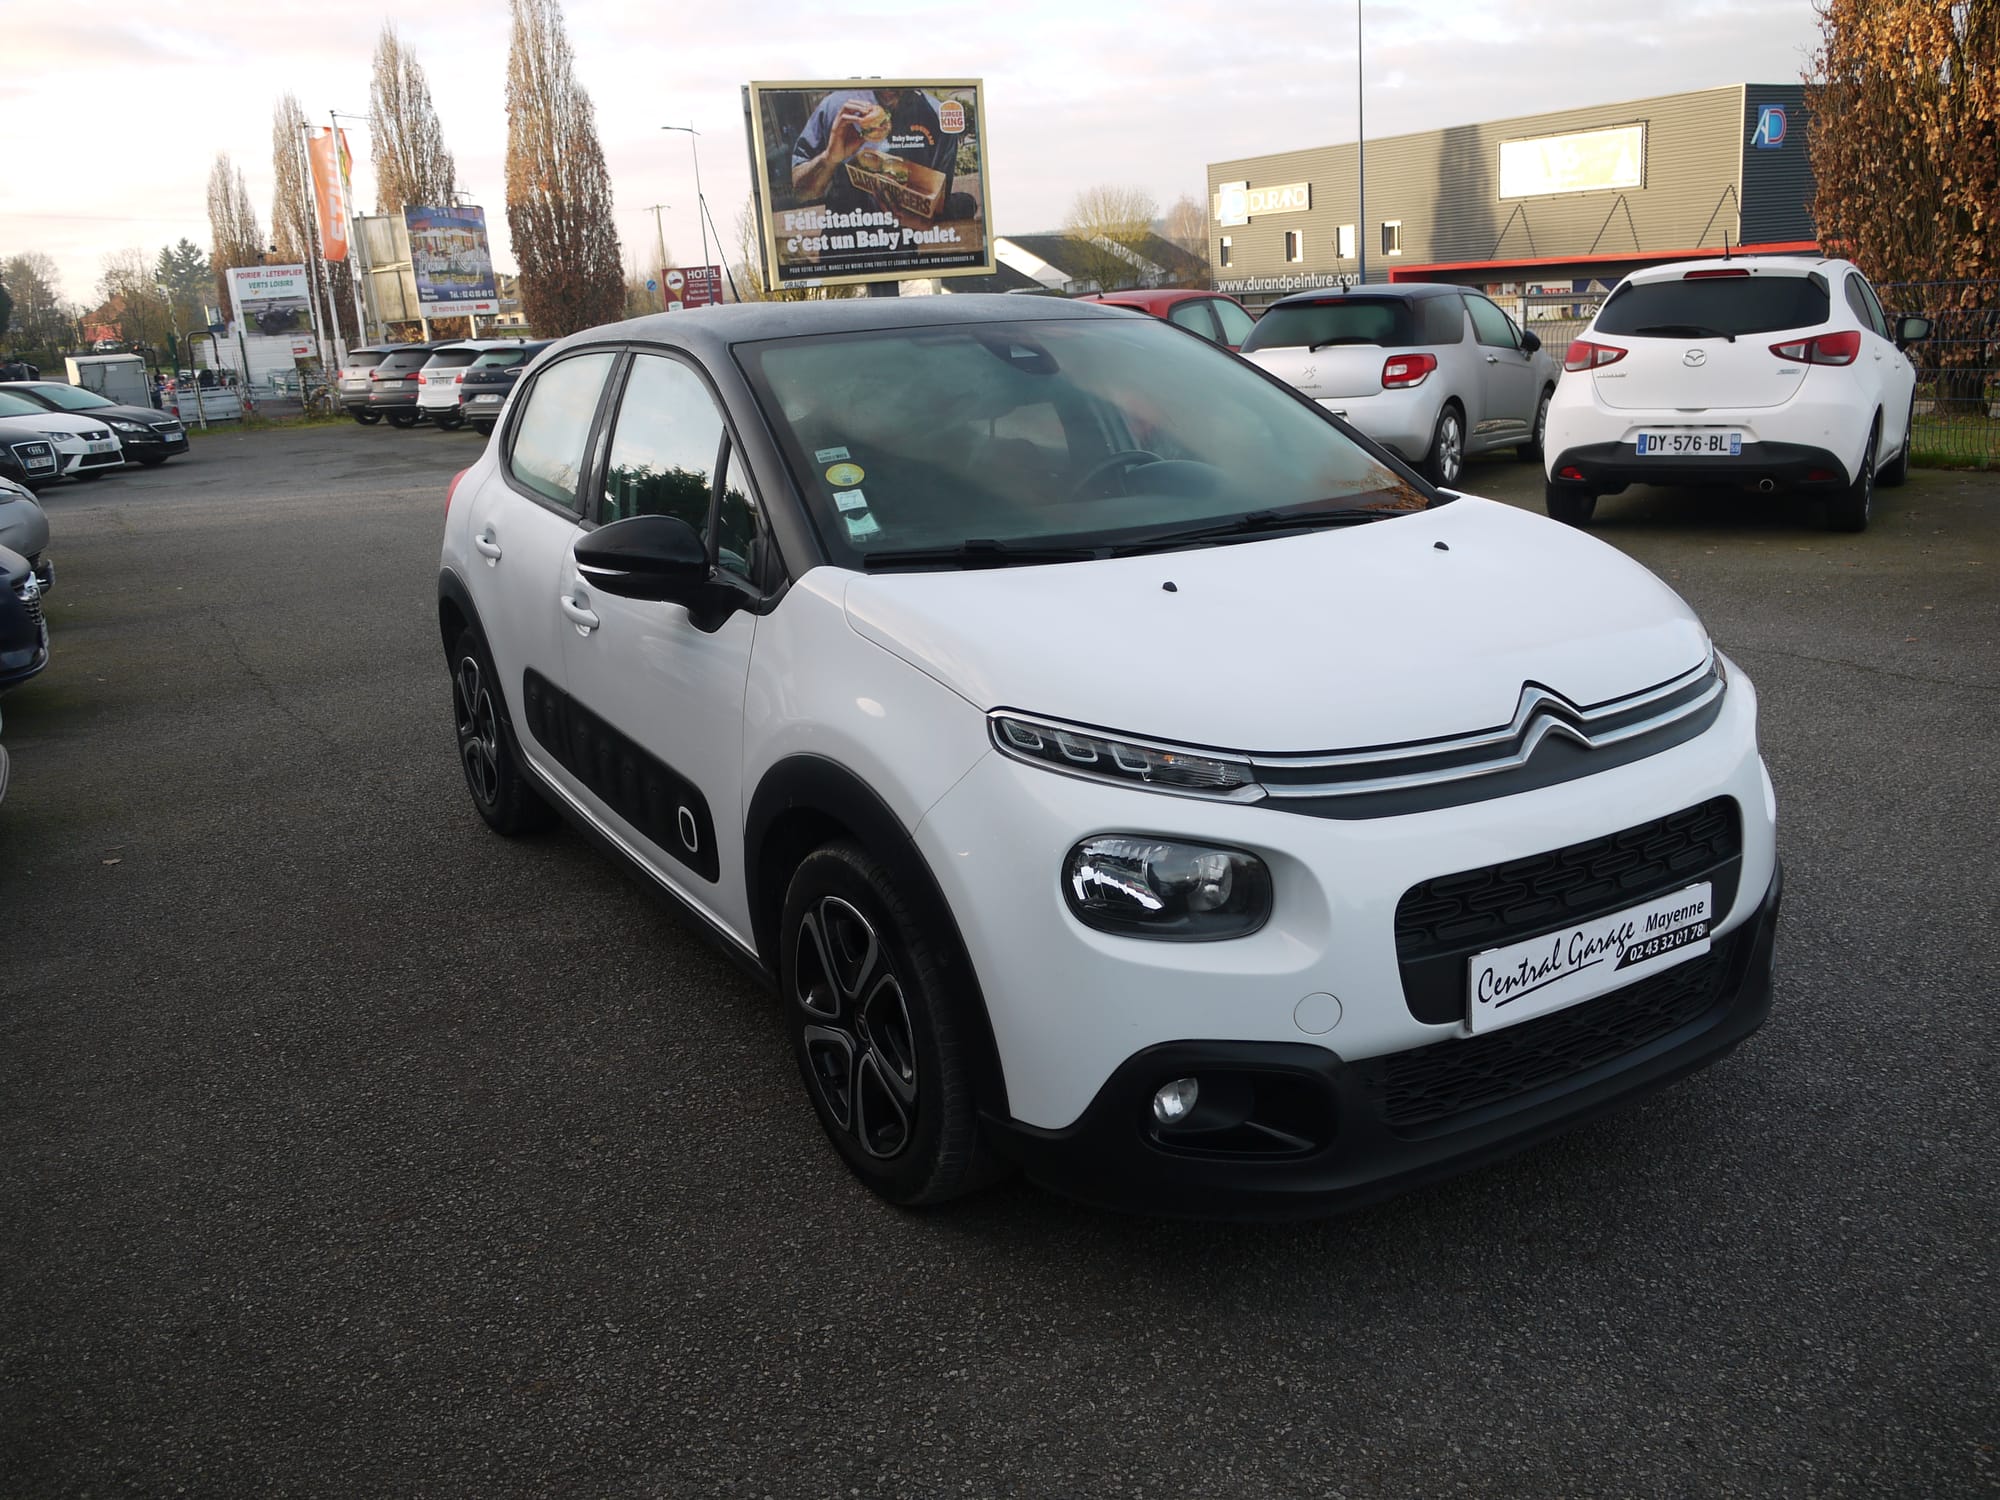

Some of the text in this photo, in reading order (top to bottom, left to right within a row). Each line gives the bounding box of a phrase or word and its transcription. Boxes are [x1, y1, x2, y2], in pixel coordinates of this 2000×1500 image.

[942, 117, 963, 127] KING
[1751, 108, 1787, 144] AD
[1250, 187, 1305, 212] DURAND
[784, 208, 899, 231] Félicitations,
[787, 225, 961, 252] c'est un Baby Poulet.
[236, 271, 261, 279] POIRIER
[266, 269, 303, 277] LETEMPLIER
[248, 280, 293, 289] VERTS LOISIRS
[1648, 435, 1728, 451] DY-576-BL
[1645, 900, 1705, 932] Mayenne
[1630, 924, 1704, 961] 02 43 32 01 78
[1478, 921, 1635, 1003] Central Garage
